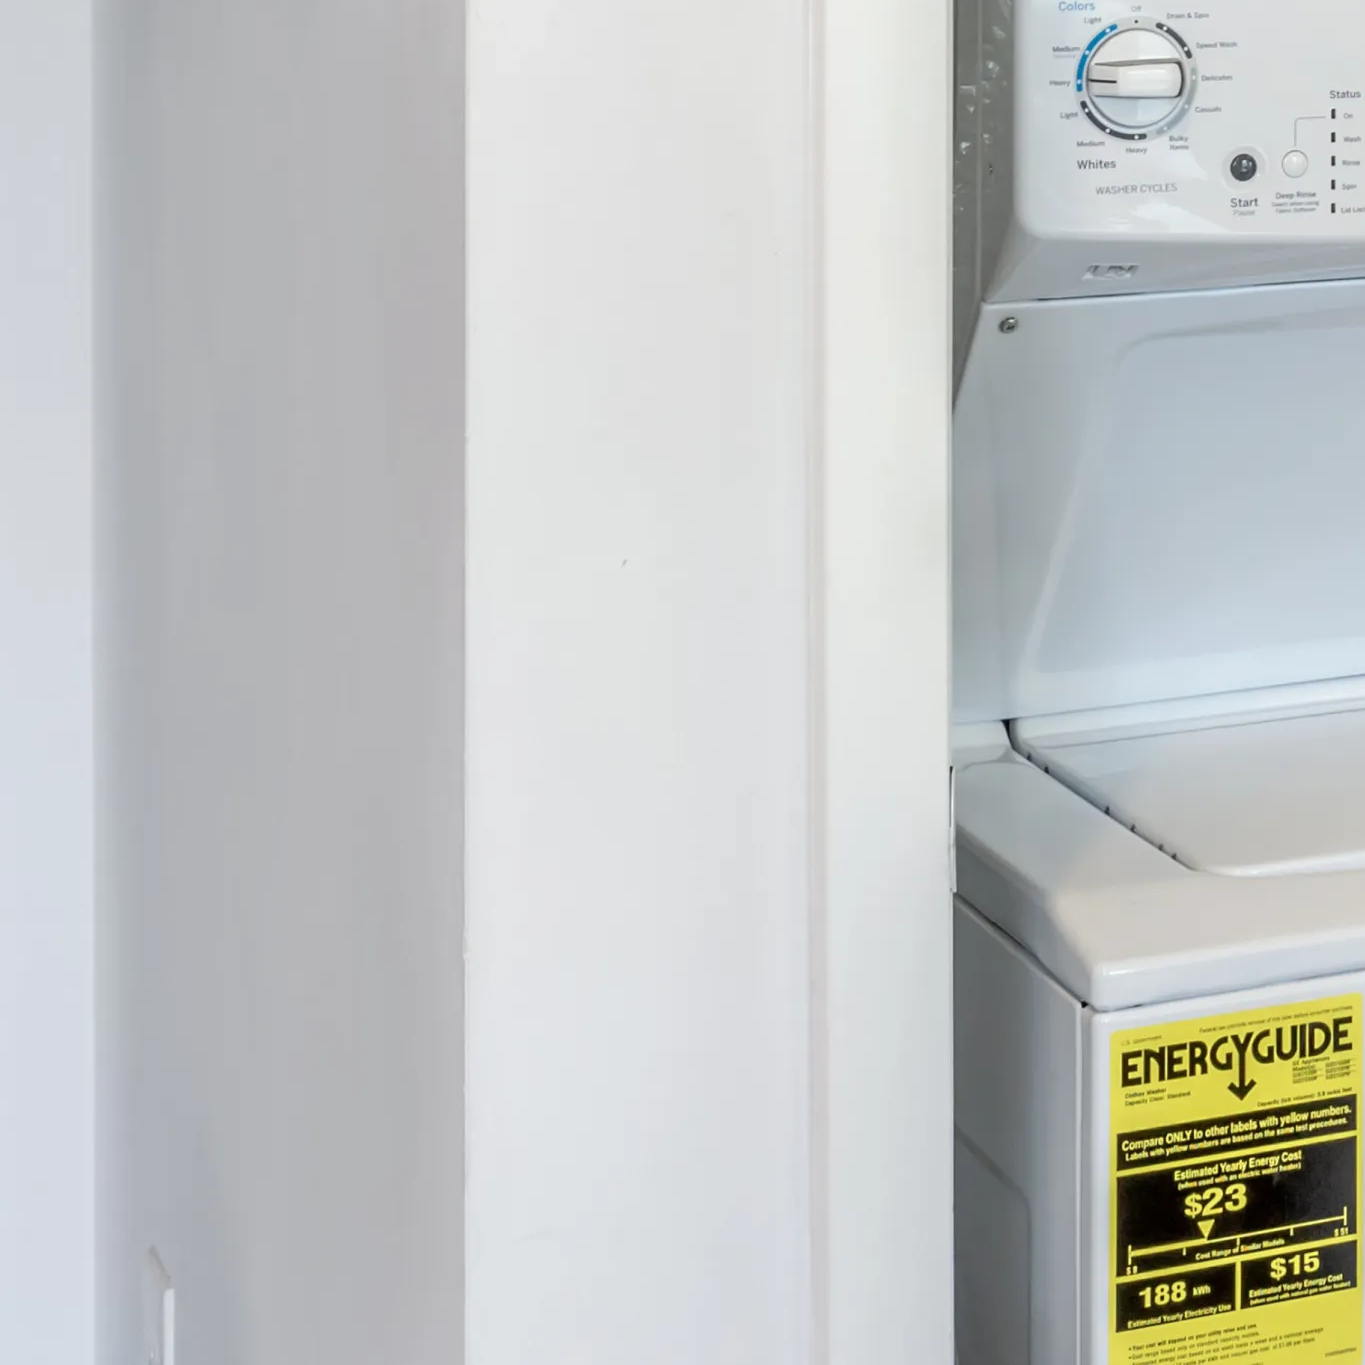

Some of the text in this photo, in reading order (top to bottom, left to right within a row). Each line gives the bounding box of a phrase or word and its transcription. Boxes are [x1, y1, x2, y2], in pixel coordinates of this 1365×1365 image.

[1058, 1, 1096, 11] Colors
[1330, 90, 1361, 99] Status
[1077, 160, 1116, 169] Whites
[1096, 183, 1177, 195] WASHER CYCLES
[1230, 198, 1258, 208] Start
[1121, 1016, 1353, 1088] ENERGYGUIDE
[1122, 1105, 1352, 1151] Compare ONLY to other labels with yellow numbers.
[1125, 1151, 1149, 1161] Labels
[1150, 1148, 1165, 1156] with
[1166, 1145, 1188, 1157] yellow
[1189, 1140, 1219, 1150] numbers
[1232, 1133, 1253, 1143] based
[1276, 1127, 1294, 1135] same
[1296, 1124, 1308, 1132] test
[1309, 1118, 1348, 1131] procedures.
[1174, 1150, 1302, 1181] Estimated Yearly Energy Cost
[1184, 1183, 1247, 1219] $23
[1195, 1252, 1211, 1260] Cost
[1212, 1248, 1231, 1257] Range
[1240, 1243, 1261, 1252] Similar
[1262, 1238, 1285, 1248] Models
[1270, 1251, 1320, 1281] $15
[1139, 1281, 1211, 1308] 188 kWh
[1249, 1273, 1343, 1298] Estimated Yearly Energy Cost
[1128, 1317, 1161, 1329] Estimated
[1163, 1313, 1183, 1322] Yearly
[1185, 1307, 1217, 1319] Electricity
